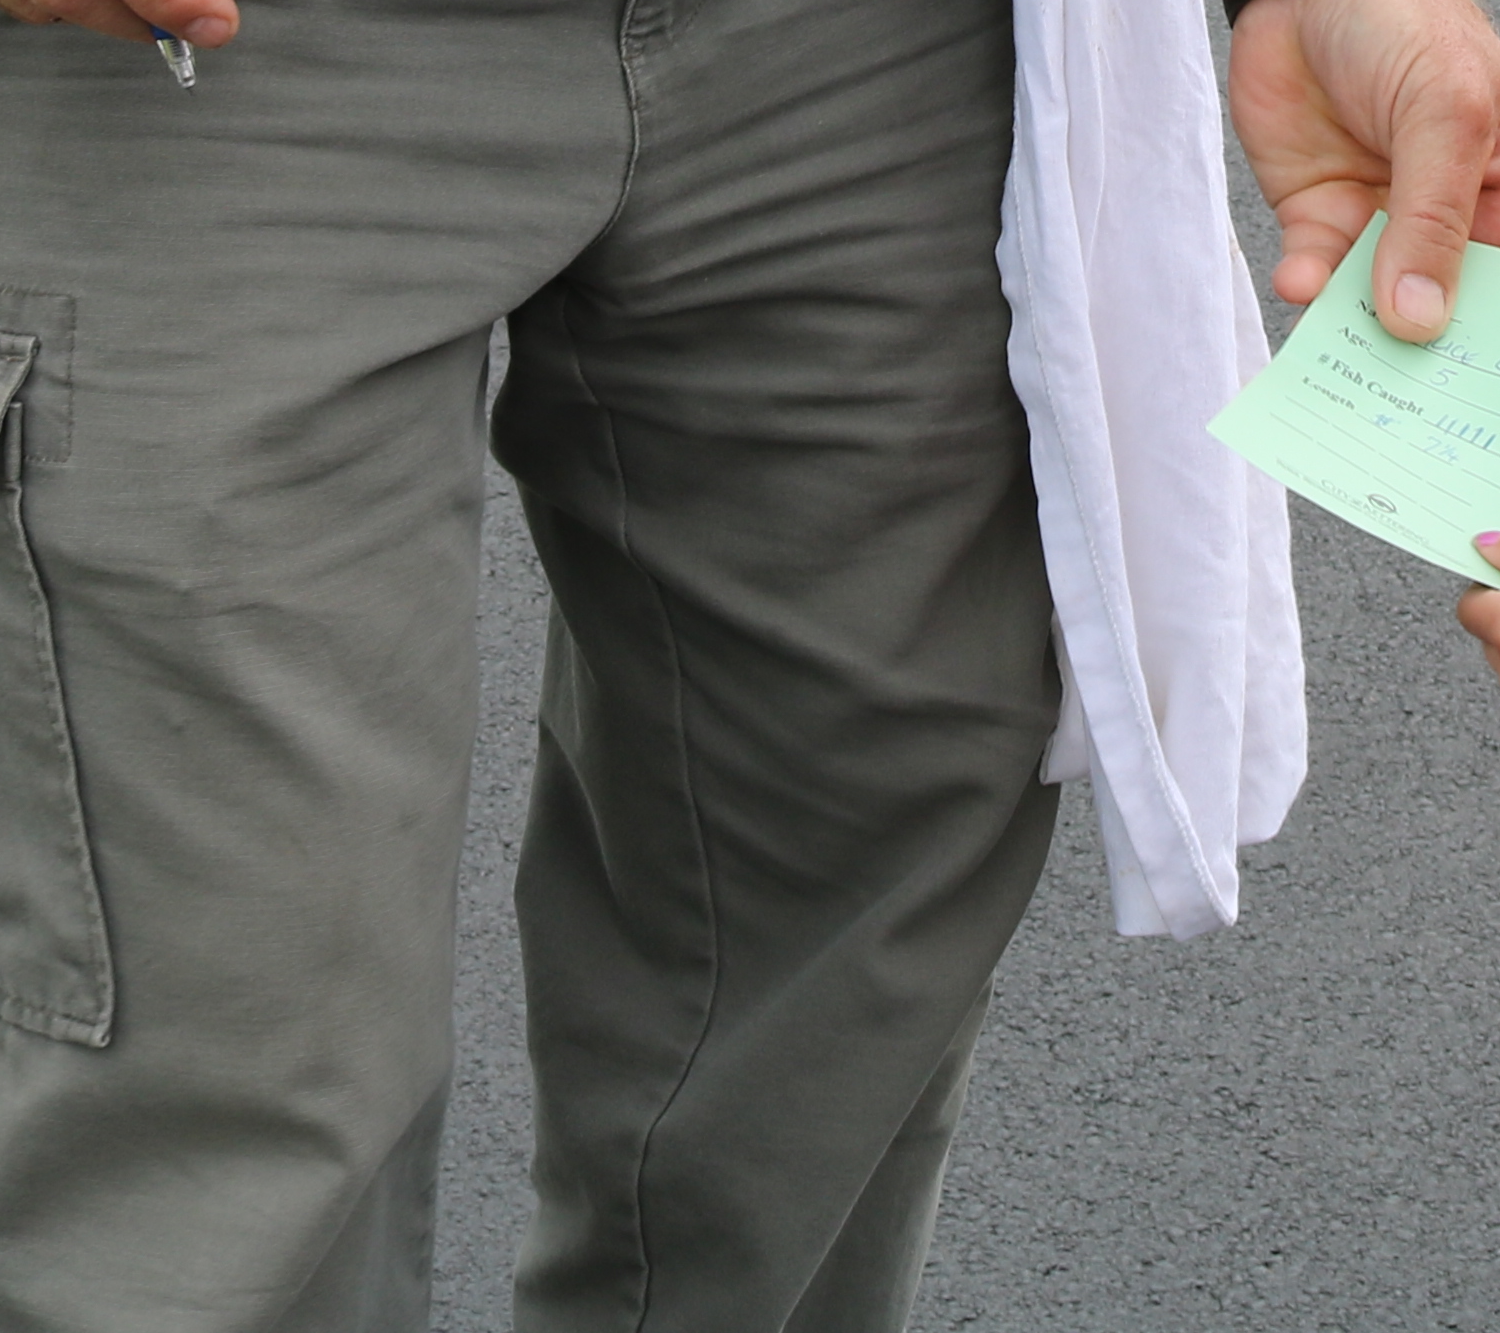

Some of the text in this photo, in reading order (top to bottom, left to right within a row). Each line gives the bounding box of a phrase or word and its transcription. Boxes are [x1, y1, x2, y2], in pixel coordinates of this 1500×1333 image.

[1337, 326, 1373, 352] Age:
[1316, 352, 1425, 417] # Fish Caught
[1429, 367, 1459, 387] 5
